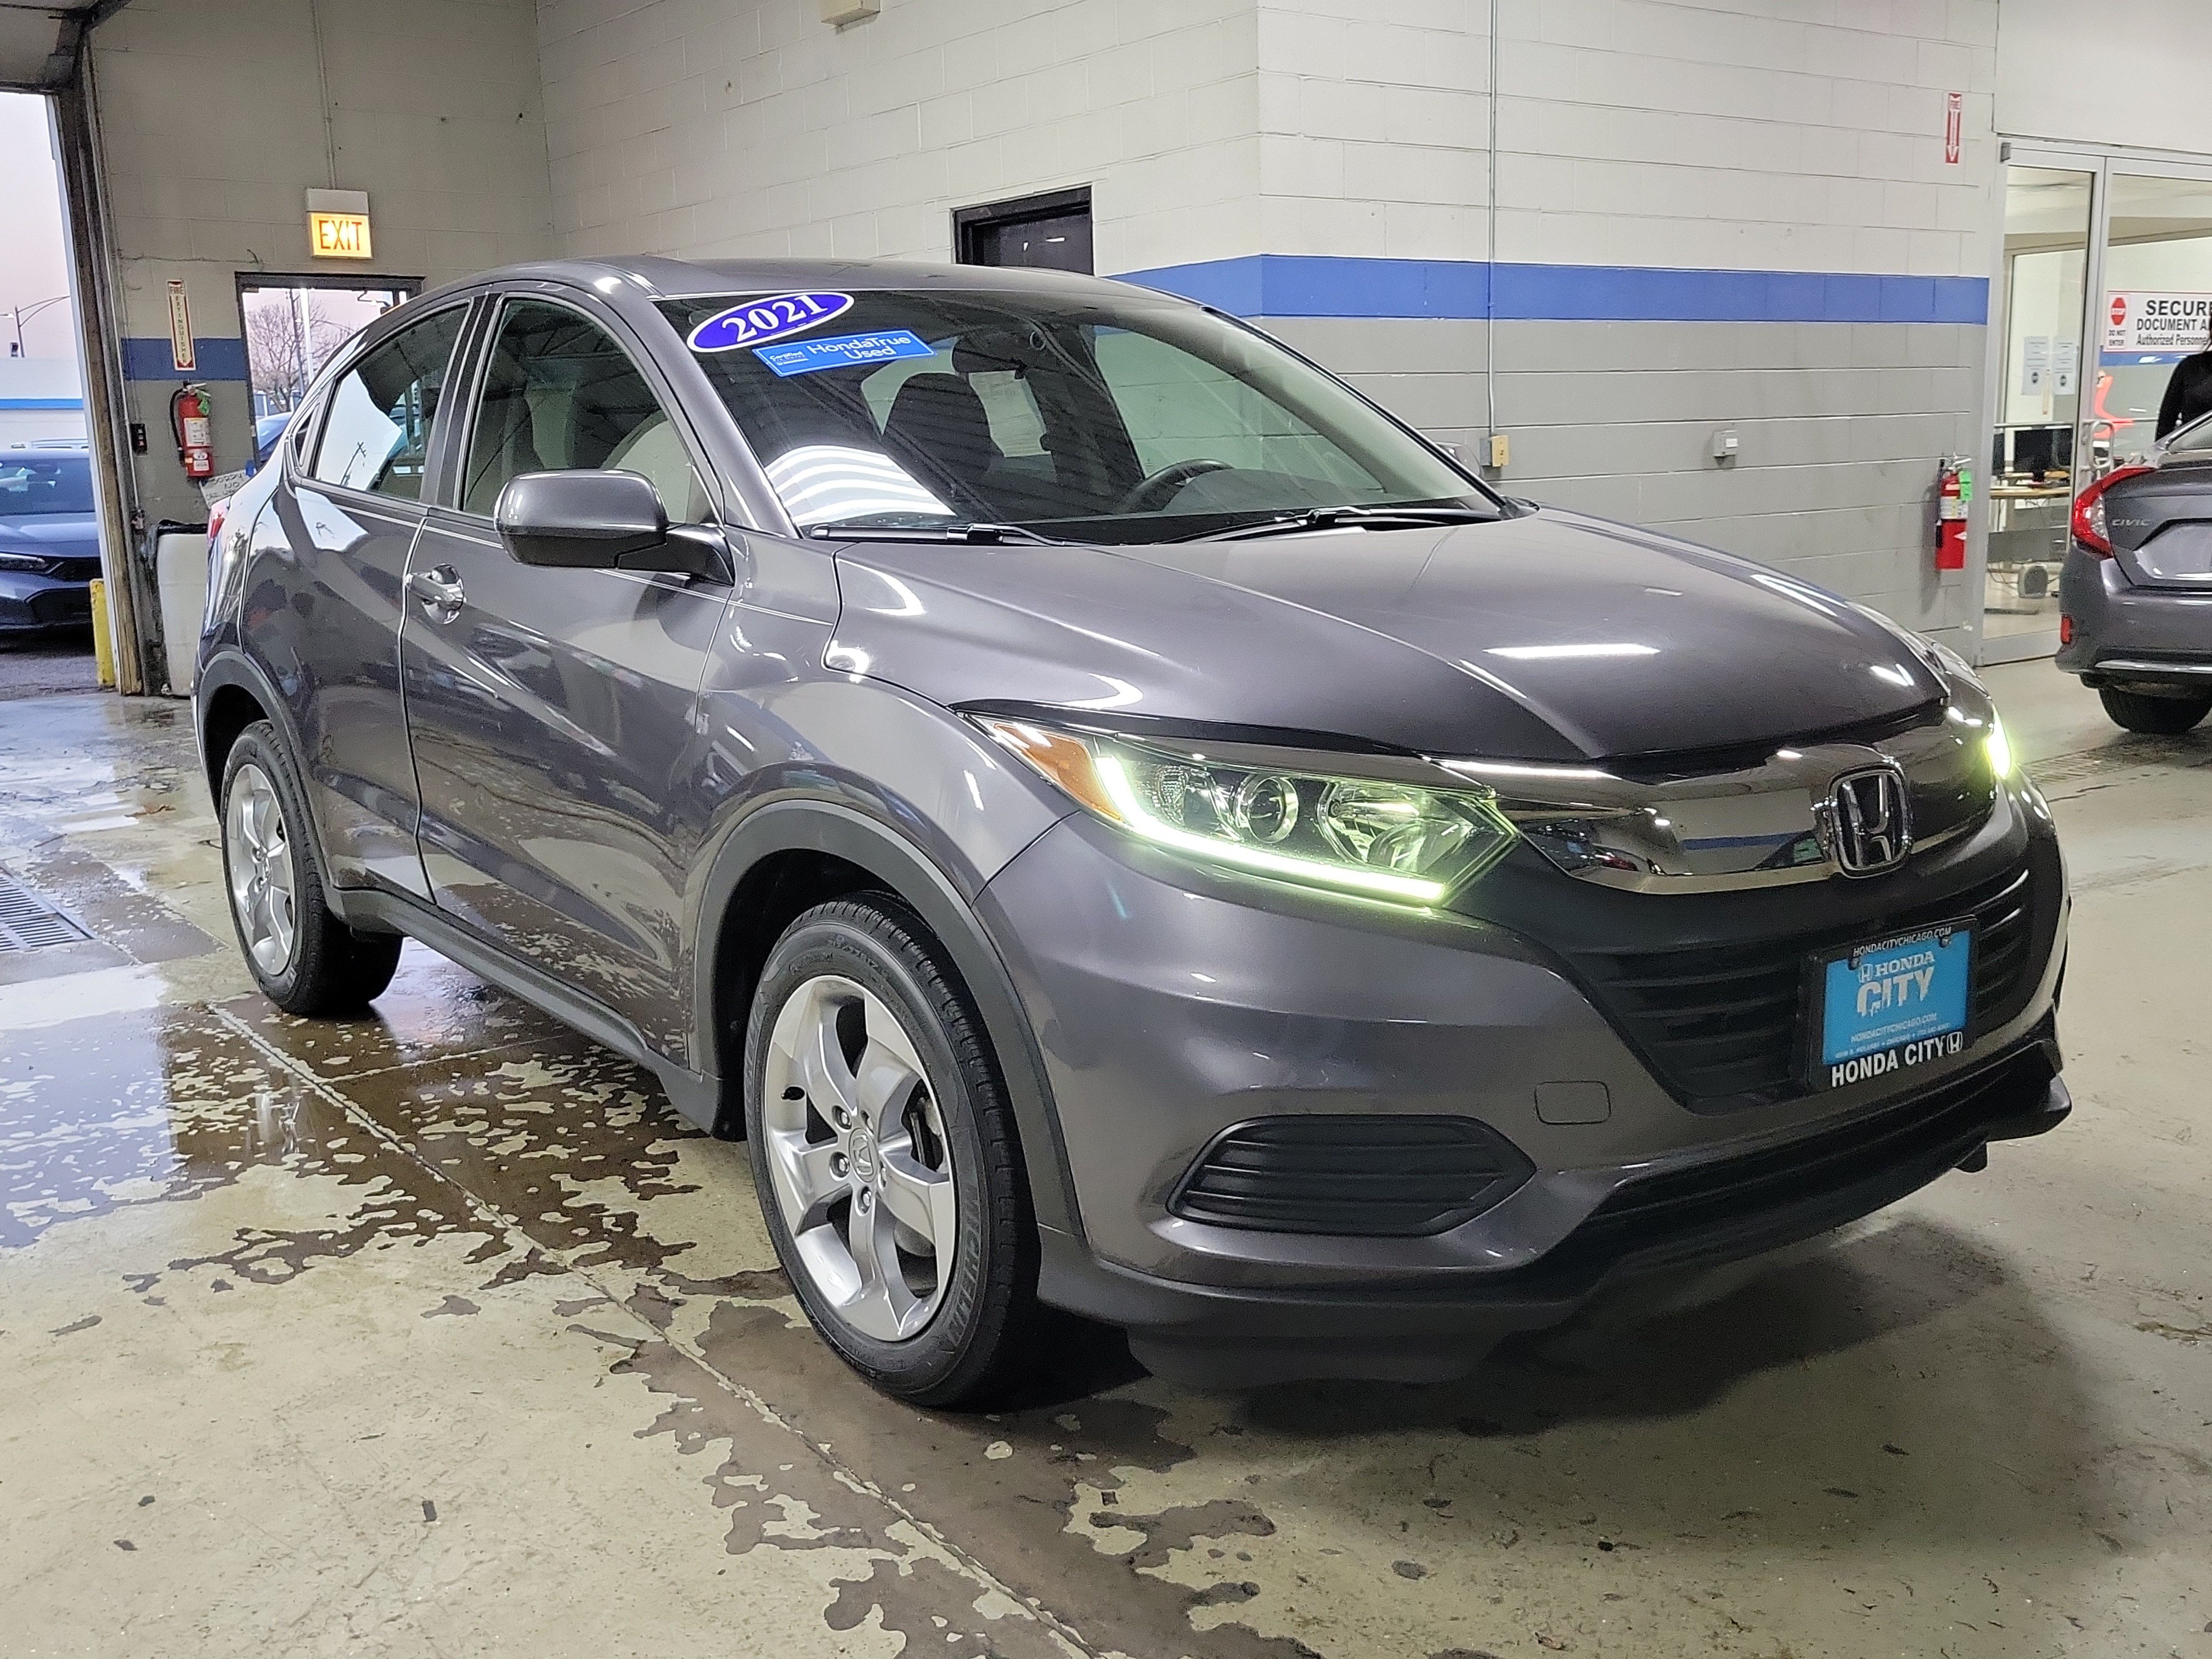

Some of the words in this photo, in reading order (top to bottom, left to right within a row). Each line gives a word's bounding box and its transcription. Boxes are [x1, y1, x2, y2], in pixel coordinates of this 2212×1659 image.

[319, 219, 362, 250] EXIT
[722, 294, 828, 342] 2021
[2146, 300, 2212, 316] SECUR
[2137, 318, 2197, 331] DOCUMENT
[806, 336, 912, 354] HondaTrue
[843, 346, 897, 359] Used
[2136, 334, 2174, 346] Authorized
[1853, 926, 1952, 957] HONDACITYCHICAGO.COM
[1875, 951, 1936, 977] HONDA
[1857, 967, 1934, 1017] CITY
[1831, 1049, 1899, 1087] HONDA
[1905, 1035, 1946, 1065] CITY
